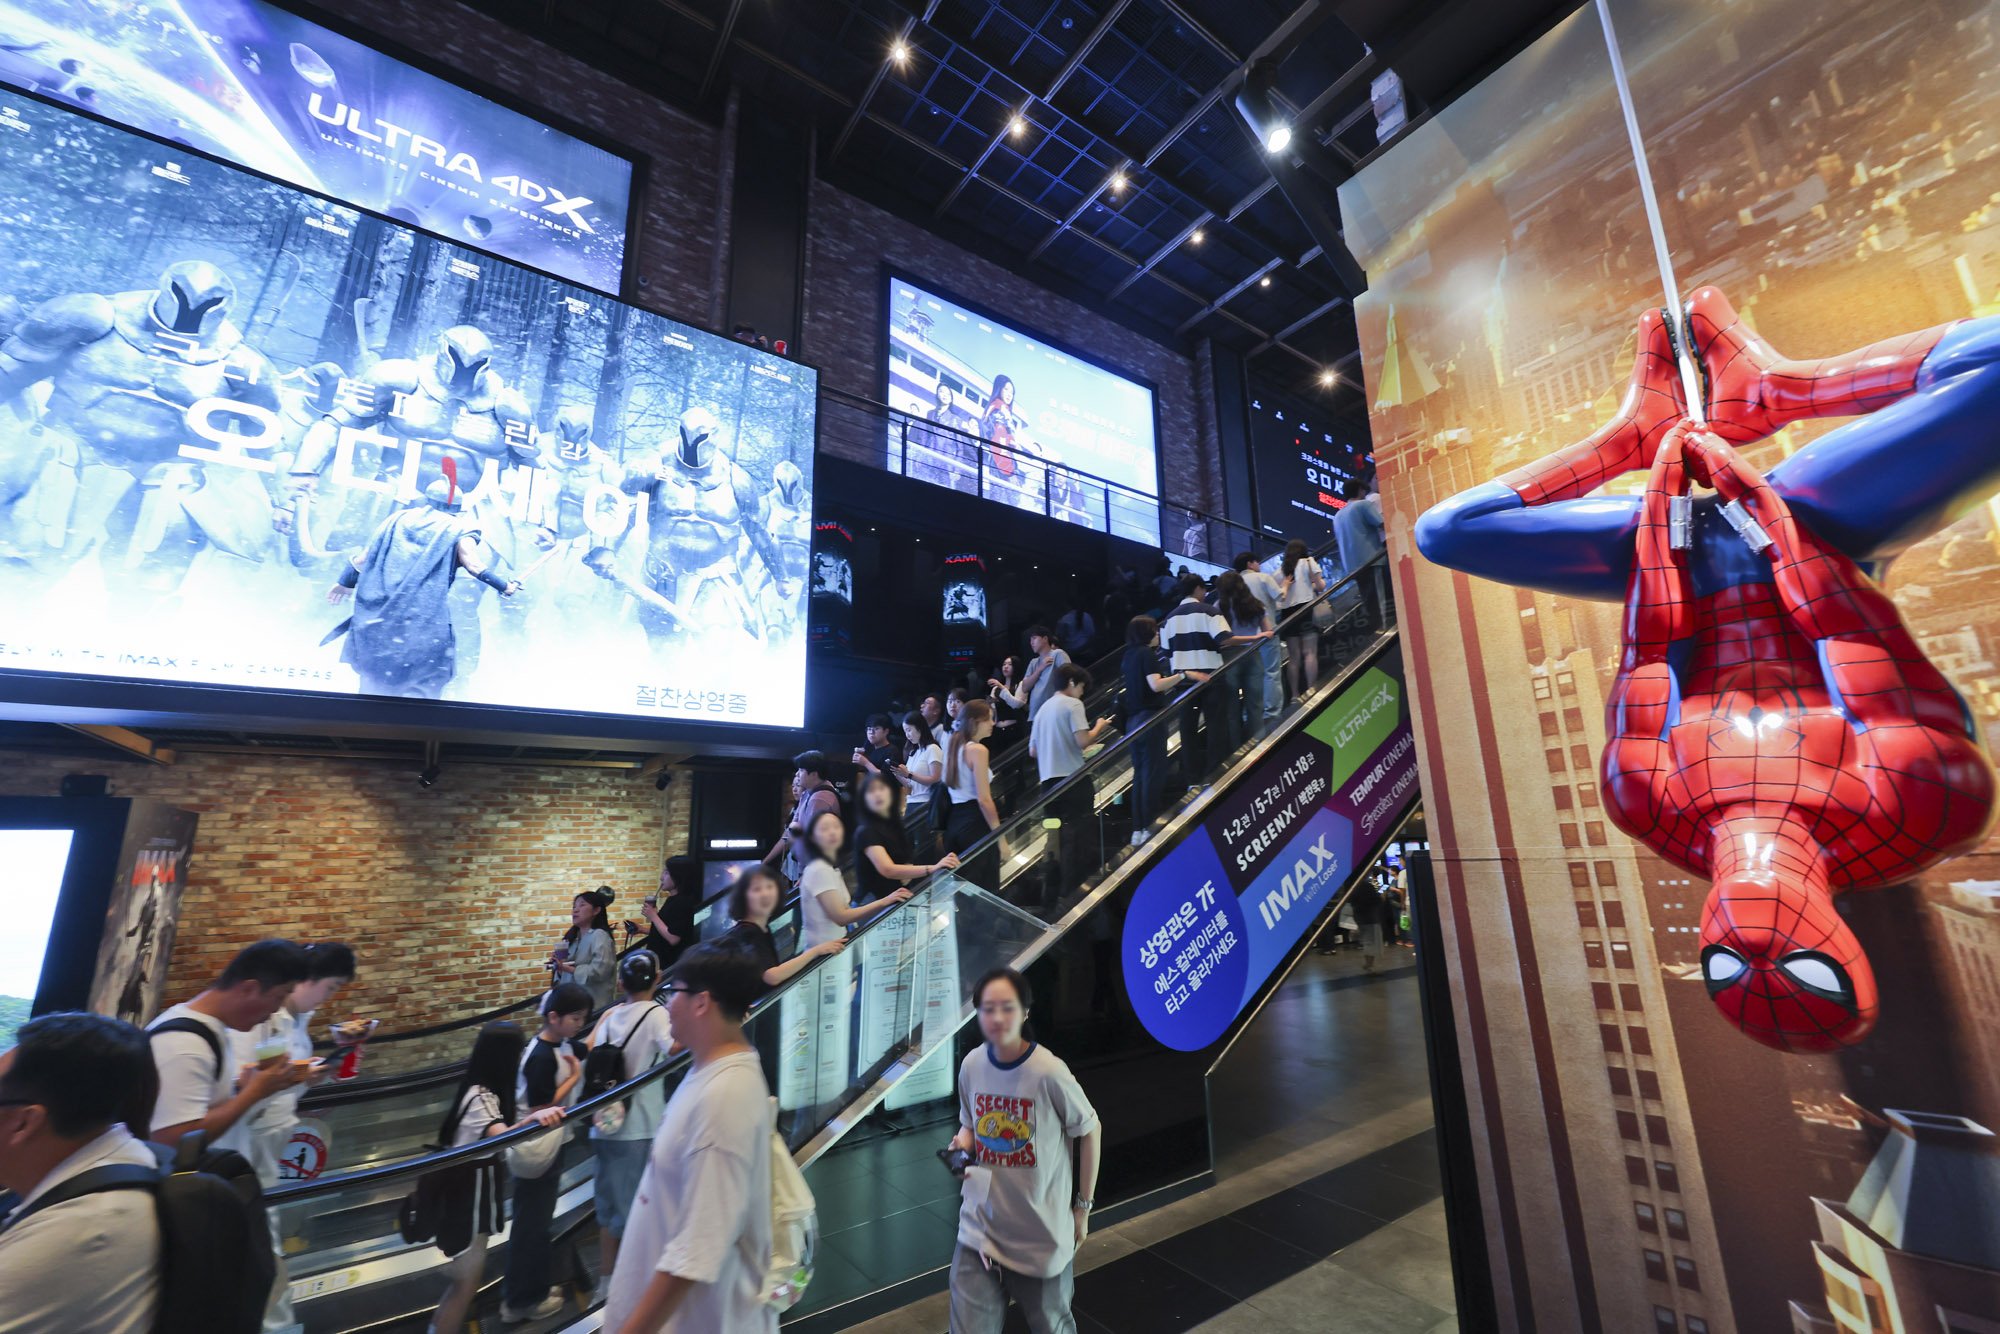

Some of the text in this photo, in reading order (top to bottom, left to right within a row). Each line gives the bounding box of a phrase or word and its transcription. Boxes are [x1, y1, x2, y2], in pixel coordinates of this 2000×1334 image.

[308, 92, 596, 234] ULTRA 4DX
[320, 132, 581, 238] ULTIMATE CINEMA EXPERIENCE
[178, 397, 650, 537] 오디세이
[118, 653, 178, 667] IMAX
[191, 659, 234, 673] FLM
[636, 685, 748, 714] 절찬상영중
[1334, 708, 1372, 748] ULTRA
[1370, 682, 1395, 712] 4DX
[1223, 813, 1252, 845] 1-2관
[1254, 785, 1282, 814] 5-7관
[1283, 752, 1316, 787] 11-18관
[1349, 763, 1386, 806] TEMPUR
[1381, 732, 1415, 771] CINEMA
[1391, 762, 1418, 799] CINEMA
[1236, 803, 1297, 872] SCREENX
[1258, 832, 1335, 931] IMAX
[1304, 859, 1338, 903] with Laser
[1140, 880, 1216, 969] 상영관은 7F
[1154, 910, 1229, 994] 에스컬레이터를
[1164, 931, 1238, 1015] 타고 올라가세요
[976, 1094, 1033, 1121] SECRET
[976, 1139, 1036, 1168] PASTURES
